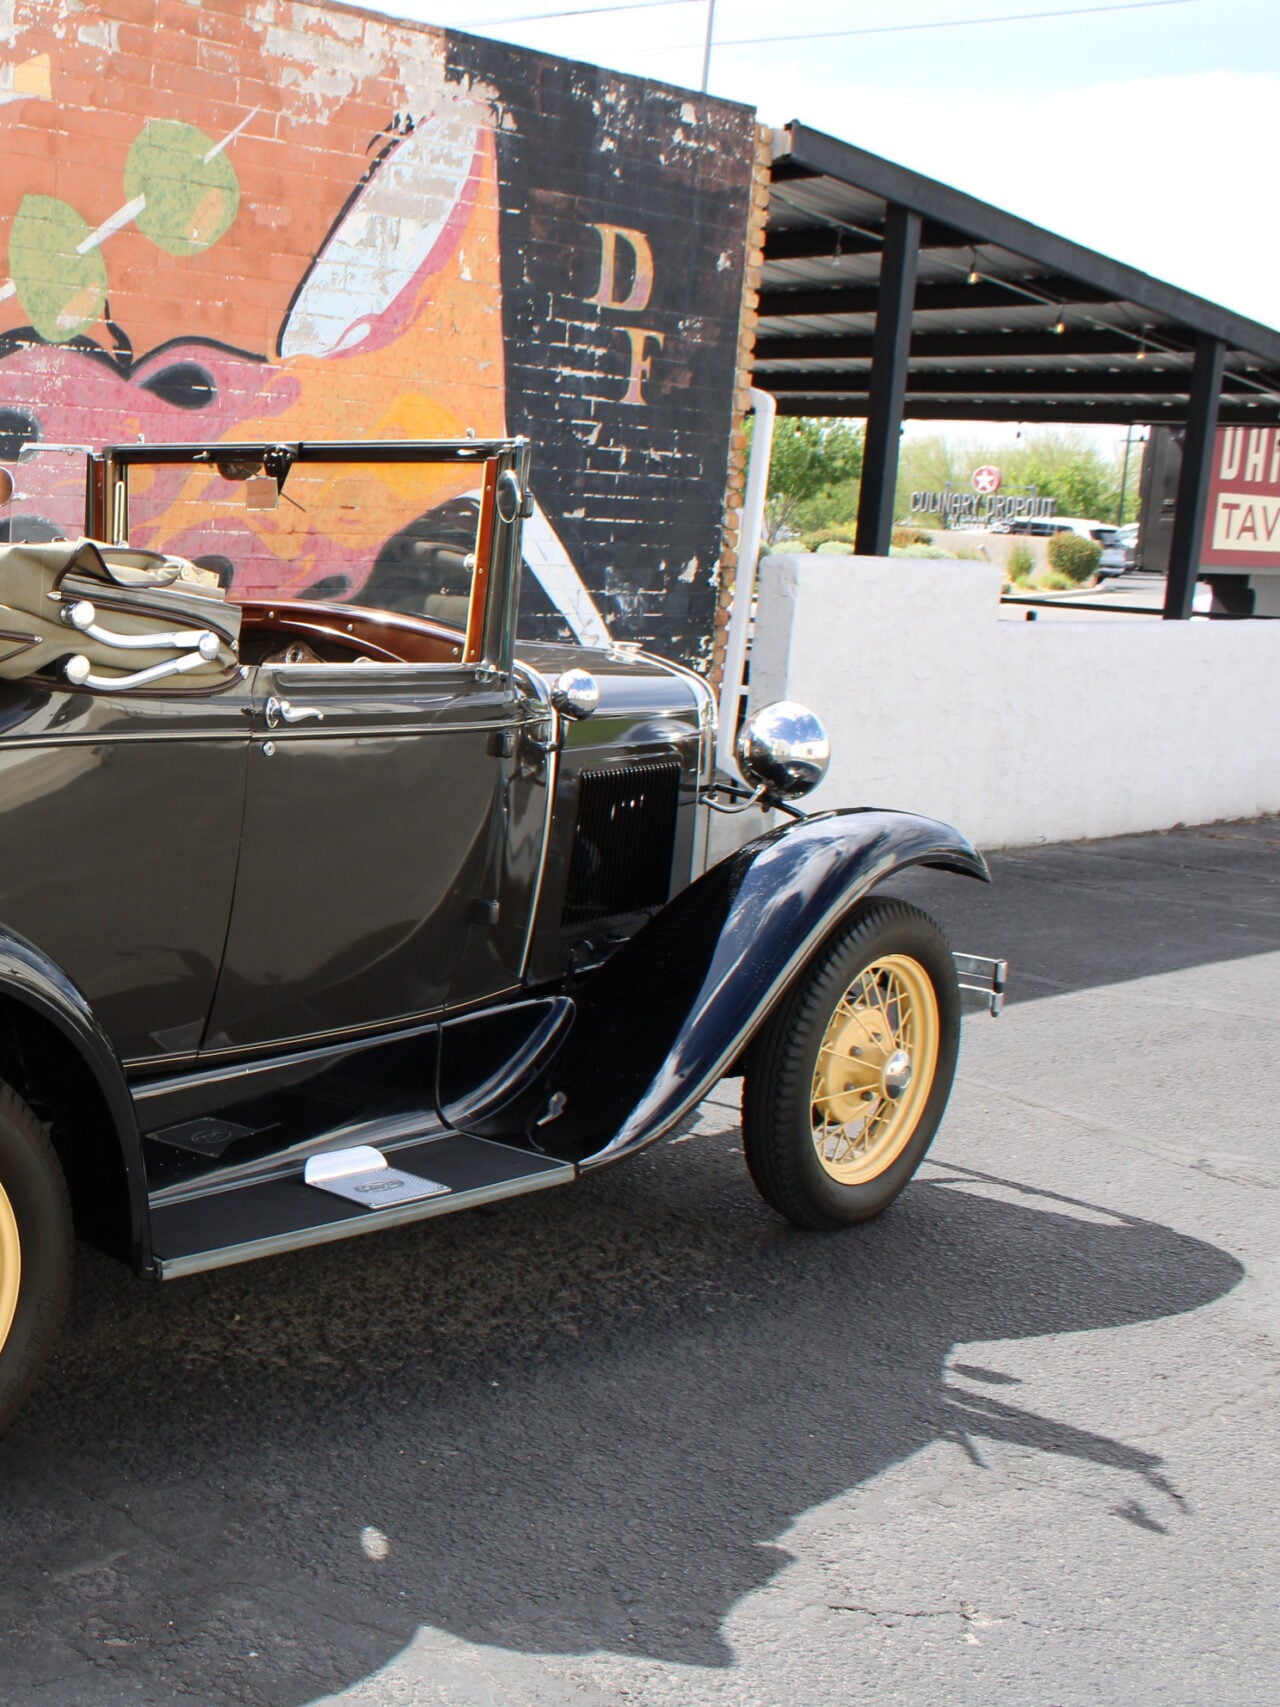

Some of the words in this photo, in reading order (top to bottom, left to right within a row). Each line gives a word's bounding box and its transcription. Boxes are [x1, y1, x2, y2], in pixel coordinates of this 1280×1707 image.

[582, 222, 654, 311] D
[618, 325, 666, 406] F
[910, 491, 981, 515] CULINARY
[985, 495, 1056, 518] DROPOUT
